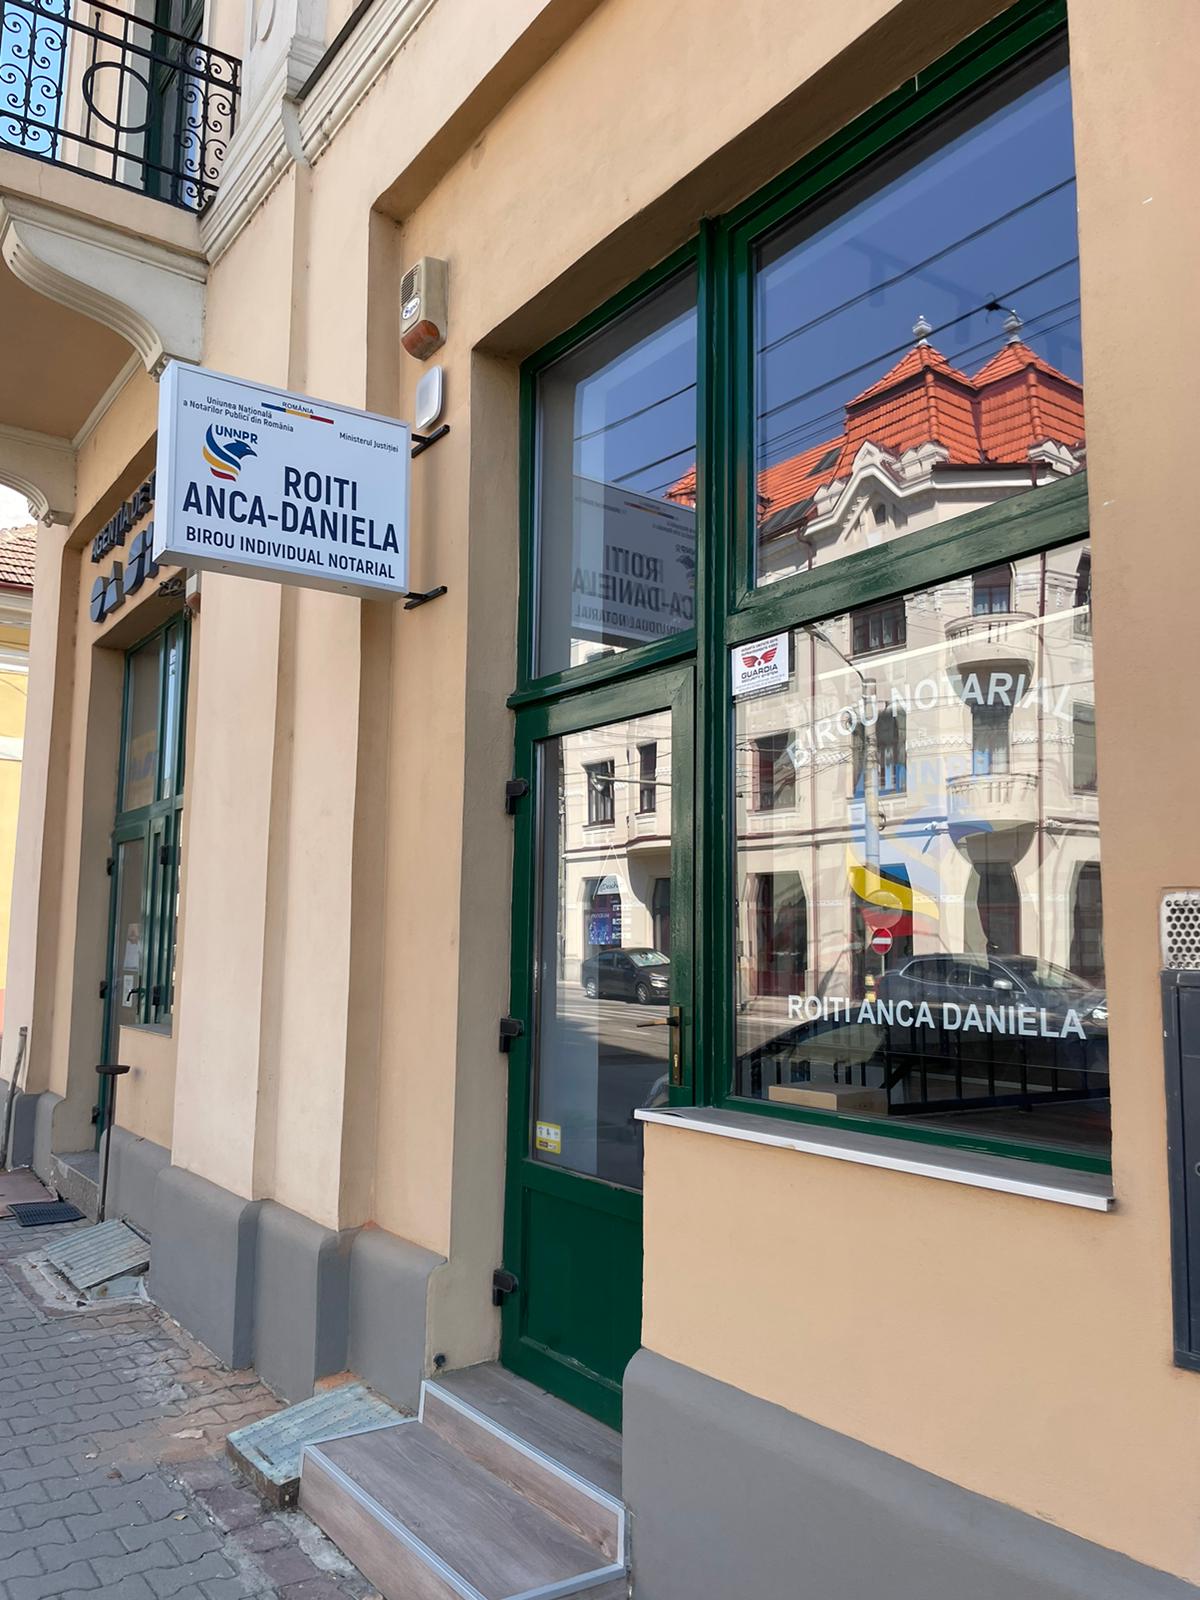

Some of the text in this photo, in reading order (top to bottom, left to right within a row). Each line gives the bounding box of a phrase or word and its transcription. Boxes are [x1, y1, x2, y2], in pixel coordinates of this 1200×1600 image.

[189, 400, 223, 415] Notarilor
[224, 408, 249, 421] Publici
[250, 415, 262, 425] din
[263, 418, 294, 432] România
[206, 396, 237, 410] Uniunea
[281, 401, 314, 415] ROMÂNIA
[215, 425, 258, 445] UNNPR
[339, 432, 373, 447] Ministerul
[284, 466, 358, 511] ROITI
[182, 481, 399, 554] ANCA-DANIELA
[186, 526, 395, 579] BIROU INDIVIDUAL NOTARIAL
[741, 664, 778, 679] GUARDIA
[787, 672, 1074, 769] BIROU NOTARIAL
[788, 995, 1087, 1040] ROITI ANCA DANIELA
